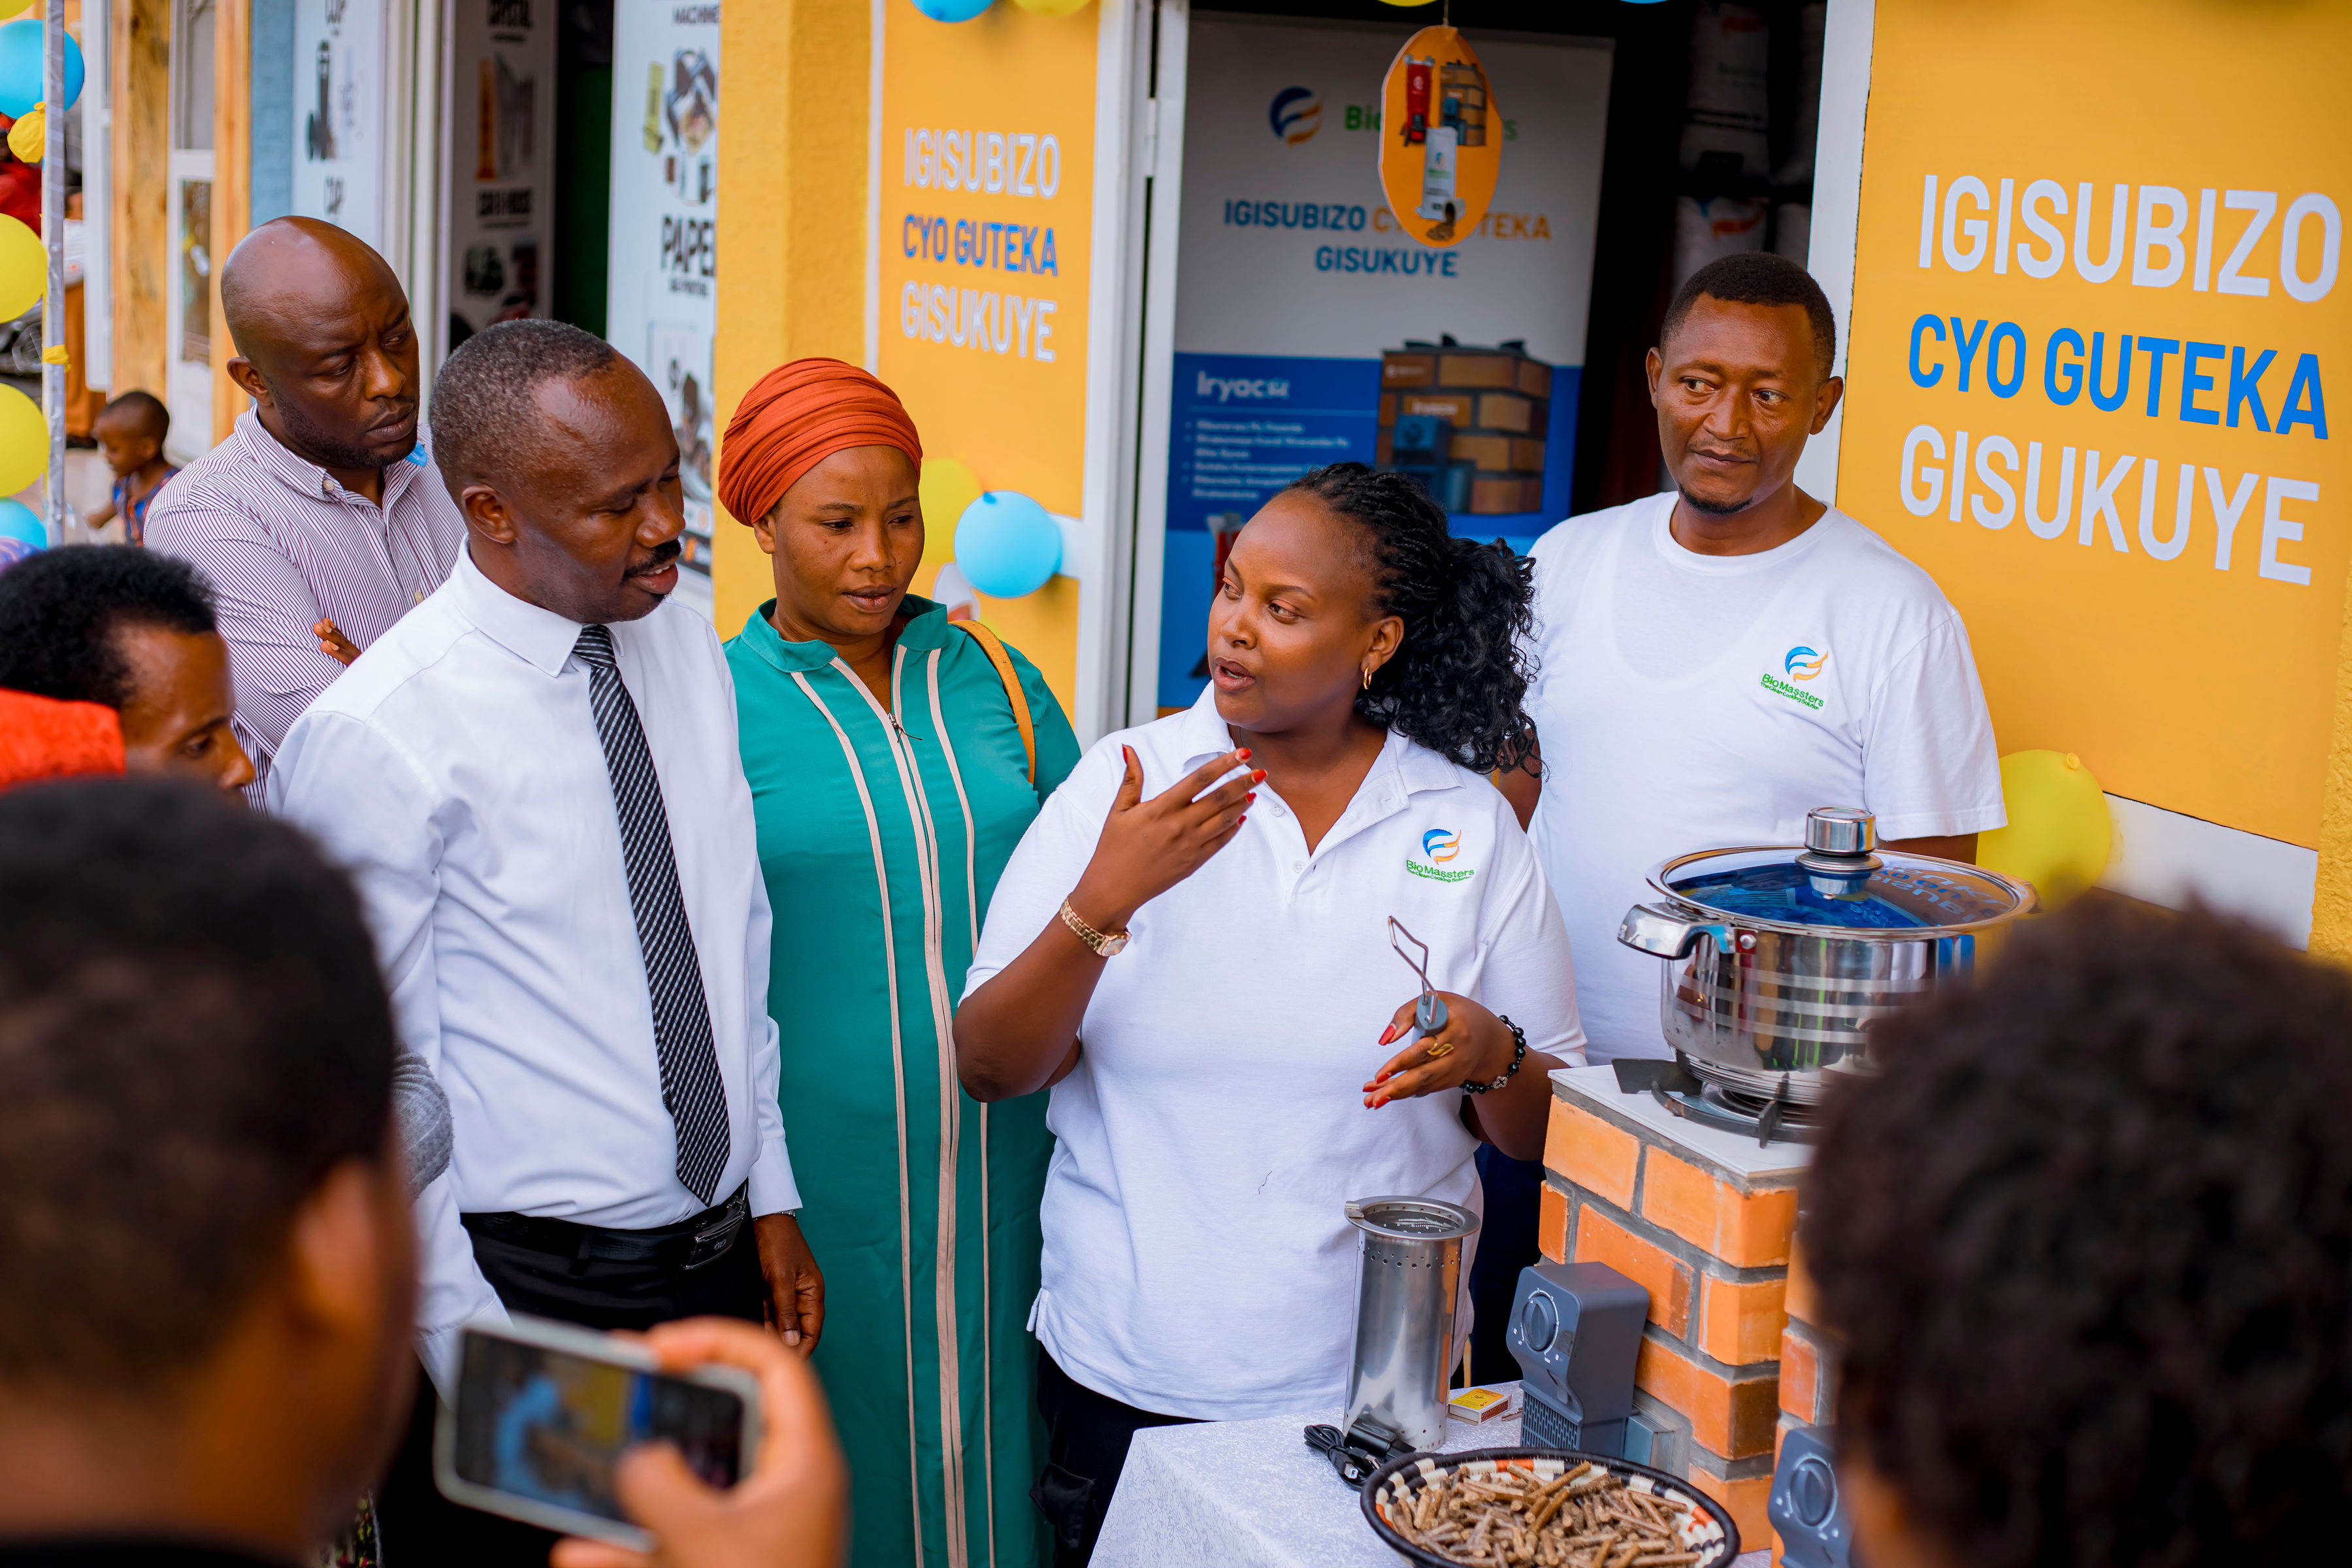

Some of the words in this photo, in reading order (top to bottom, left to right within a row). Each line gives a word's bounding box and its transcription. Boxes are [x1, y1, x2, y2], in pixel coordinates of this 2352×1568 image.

[904, 127, 1061, 199] IGISUBIZO
[903, 213, 949, 263] CYO
[953, 218, 1059, 277] GUTEKA
[1224, 200, 1367, 231] IGISUBIZO
[1918, 174, 2343, 304] IGISUBIZO
[1315, 245, 1460, 278] GISUKUYE
[901, 280, 1057, 363] GISUKUYE
[1909, 314, 2027, 399] CYO
[2044, 327, 2328, 440] GUTEKA
[1900, 424, 2320, 586] GISUKUYE
